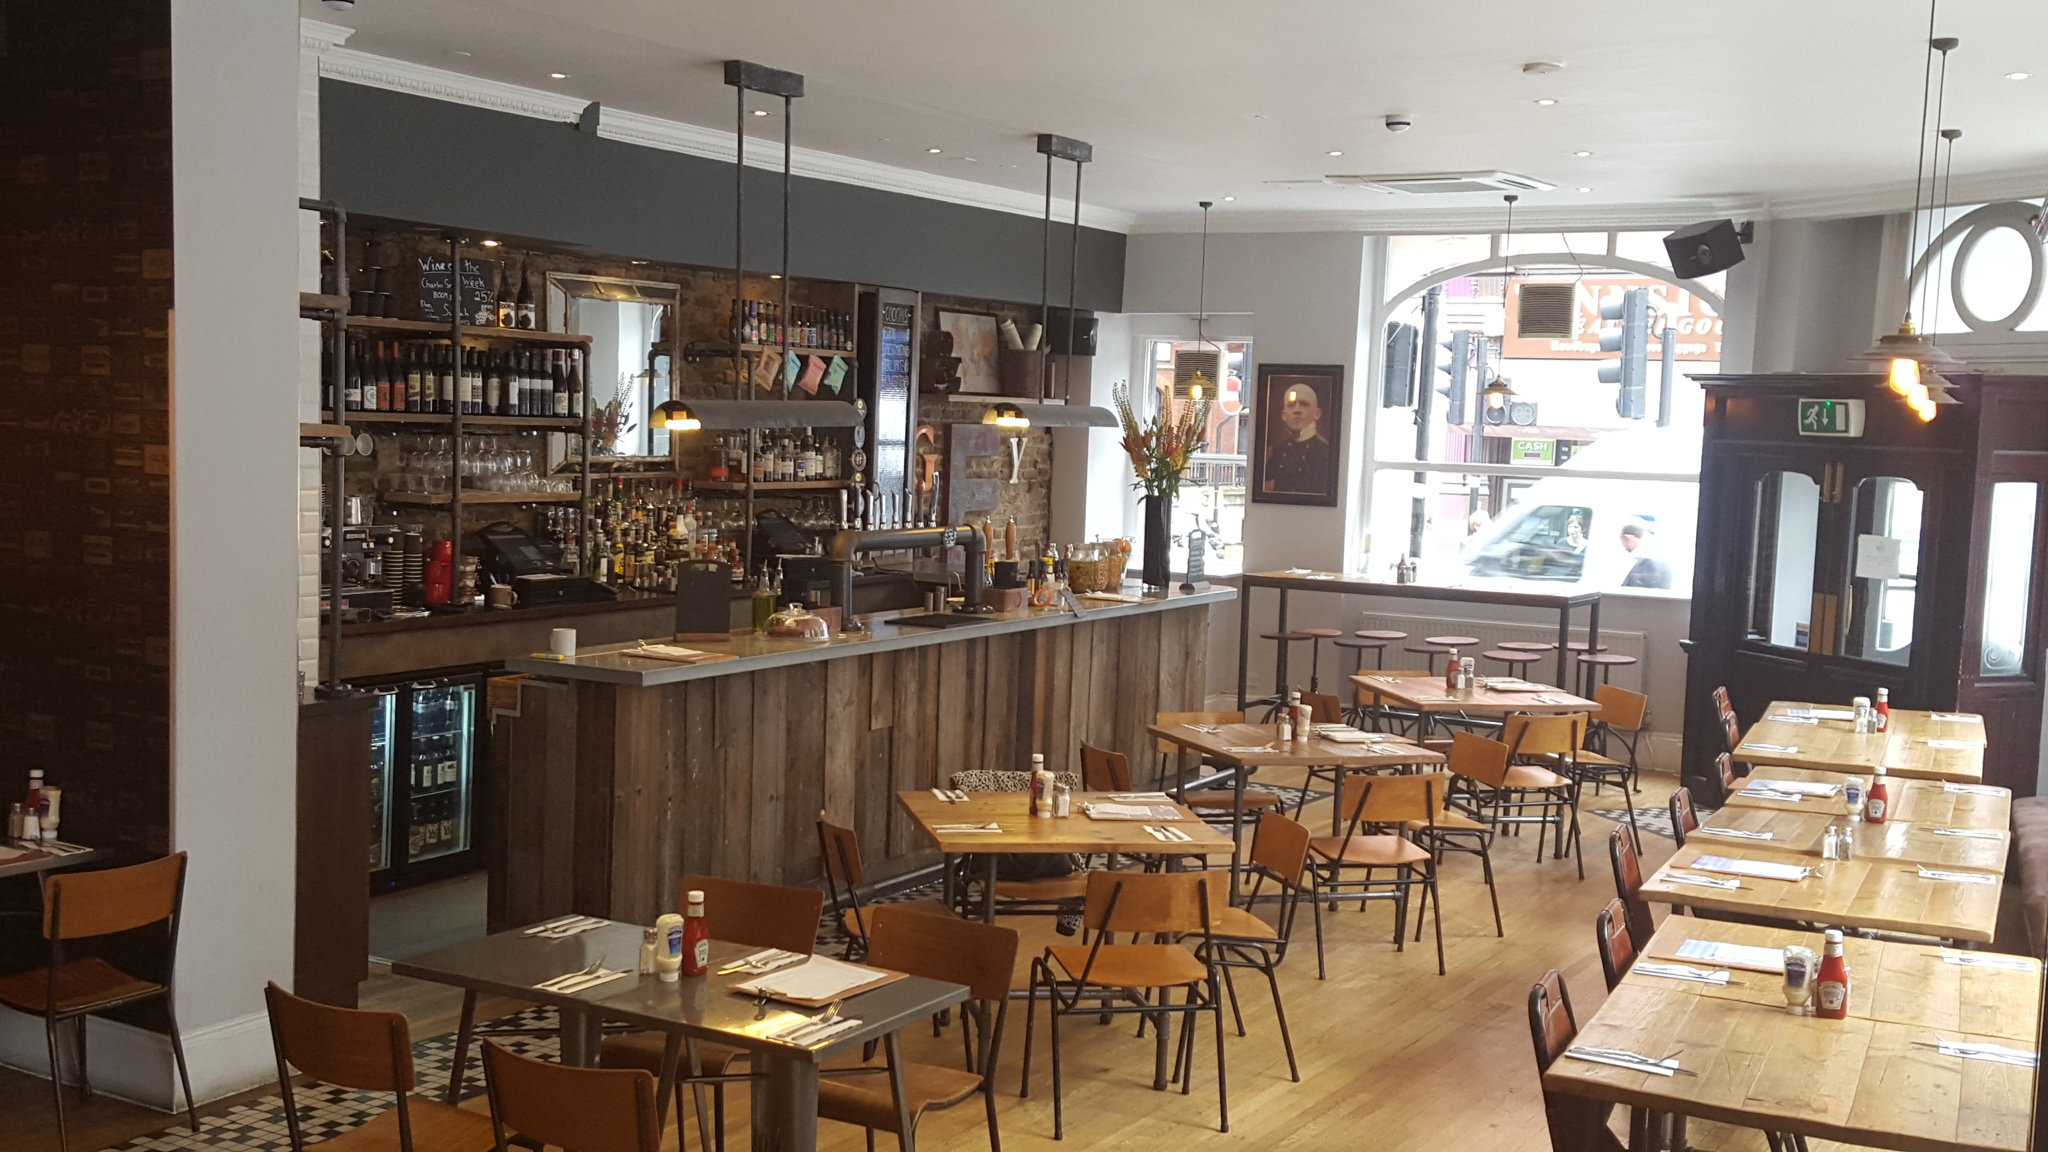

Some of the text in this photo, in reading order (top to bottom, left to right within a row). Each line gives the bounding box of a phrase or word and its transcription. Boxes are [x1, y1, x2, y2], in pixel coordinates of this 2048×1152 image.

[418, 256, 446, 271] Wine
[464, 260, 480, 272] the
[462, 276, 485, 288] Week
[474, 291, 494, 302] 25%
[1517, 441, 1549, 451] CASH
